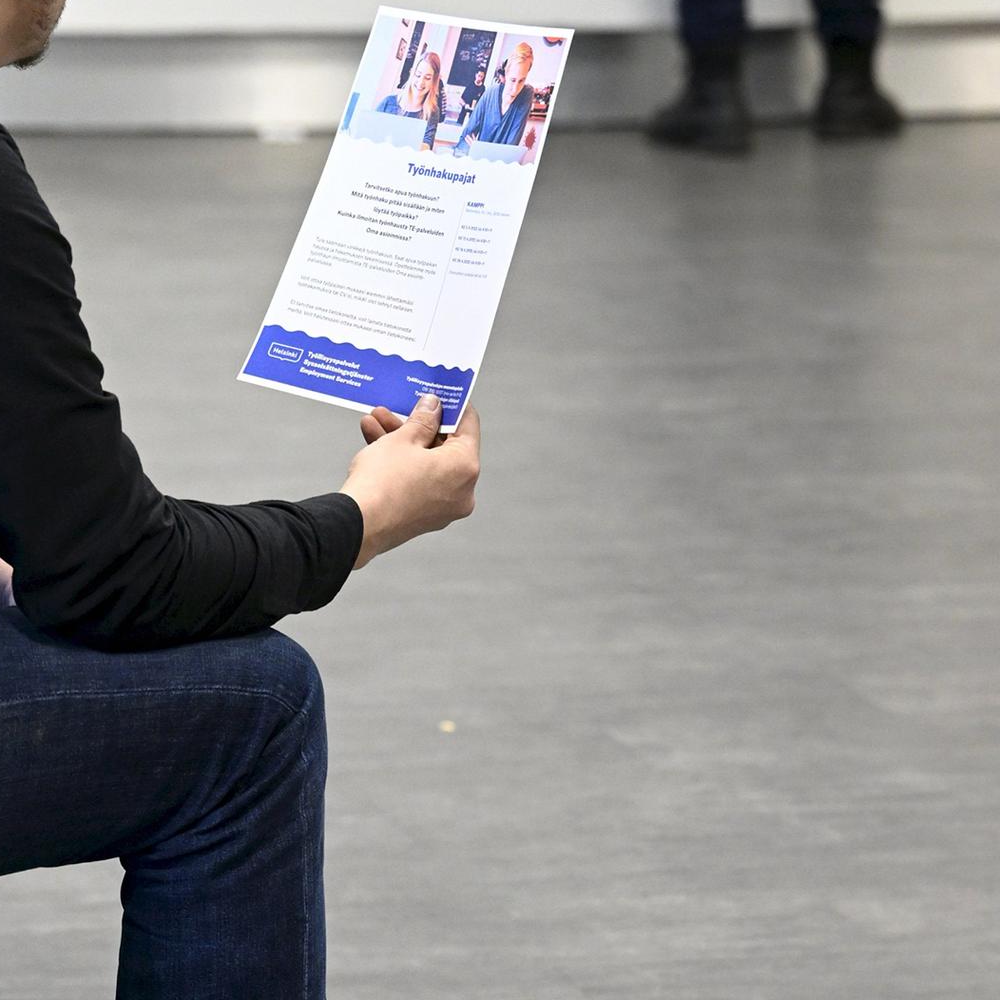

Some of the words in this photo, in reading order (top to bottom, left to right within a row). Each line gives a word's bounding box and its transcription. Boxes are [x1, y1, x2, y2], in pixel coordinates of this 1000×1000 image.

[408, 163, 476, 184] Työnhakupajat
[351, 190, 364, 198] Mitä
[389, 198, 403, 206] pitää
[364, 183, 394, 192] Tarvitsetko
[408, 191, 440, 201] työnhakuun?
[373, 206, 389, 215] löytää
[390, 211, 418, 220] työpaikka?
[379, 220, 408, 229] työnhausta
[409, 226, 445, 236] TE-palveluiden
[273, 348, 297, 357] Helsinki
[308, 351, 360, 369] Työllisyyspalvelut
[299, 367, 336, 380] Employment
[336, 376, 361, 386] Services
